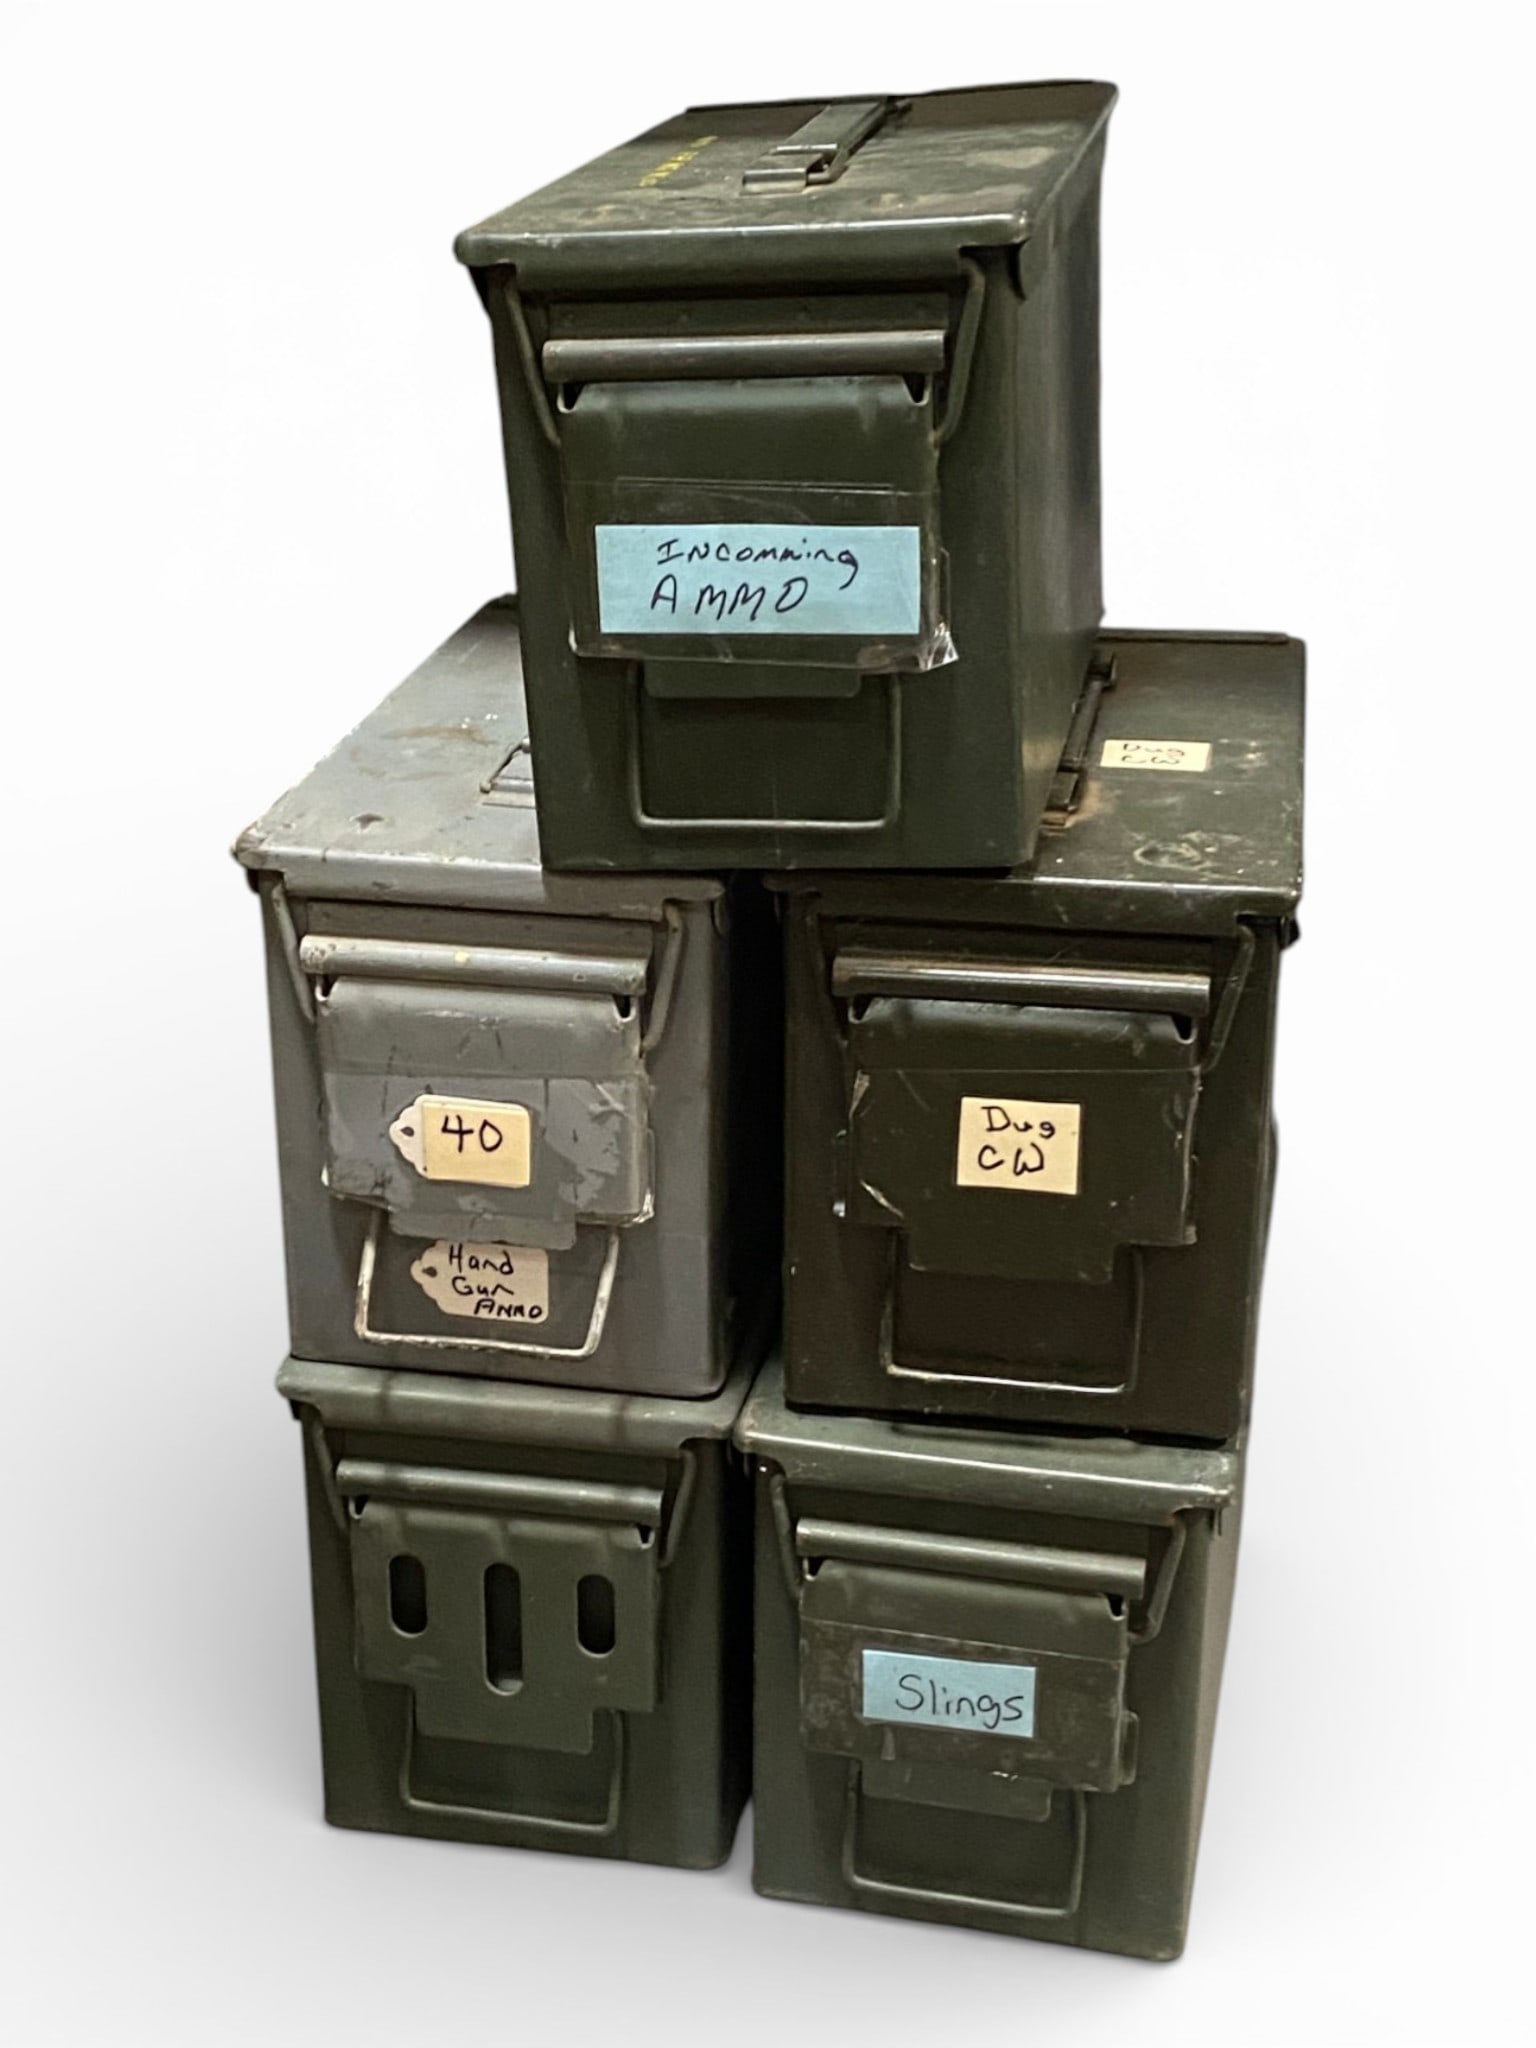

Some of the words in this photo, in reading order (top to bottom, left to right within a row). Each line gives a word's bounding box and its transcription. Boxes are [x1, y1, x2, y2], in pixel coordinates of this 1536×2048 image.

[650, 573, 809, 621] AMMO
[441, 1115, 503, 1153] 40
[980, 1105, 1056, 1140] Dug
[977, 1142, 1045, 1177] CW
[449, 1243, 514, 1275] Hand
[451, 1275, 515, 1296] Gun
[895, 1673, 1025, 1730] Slings
